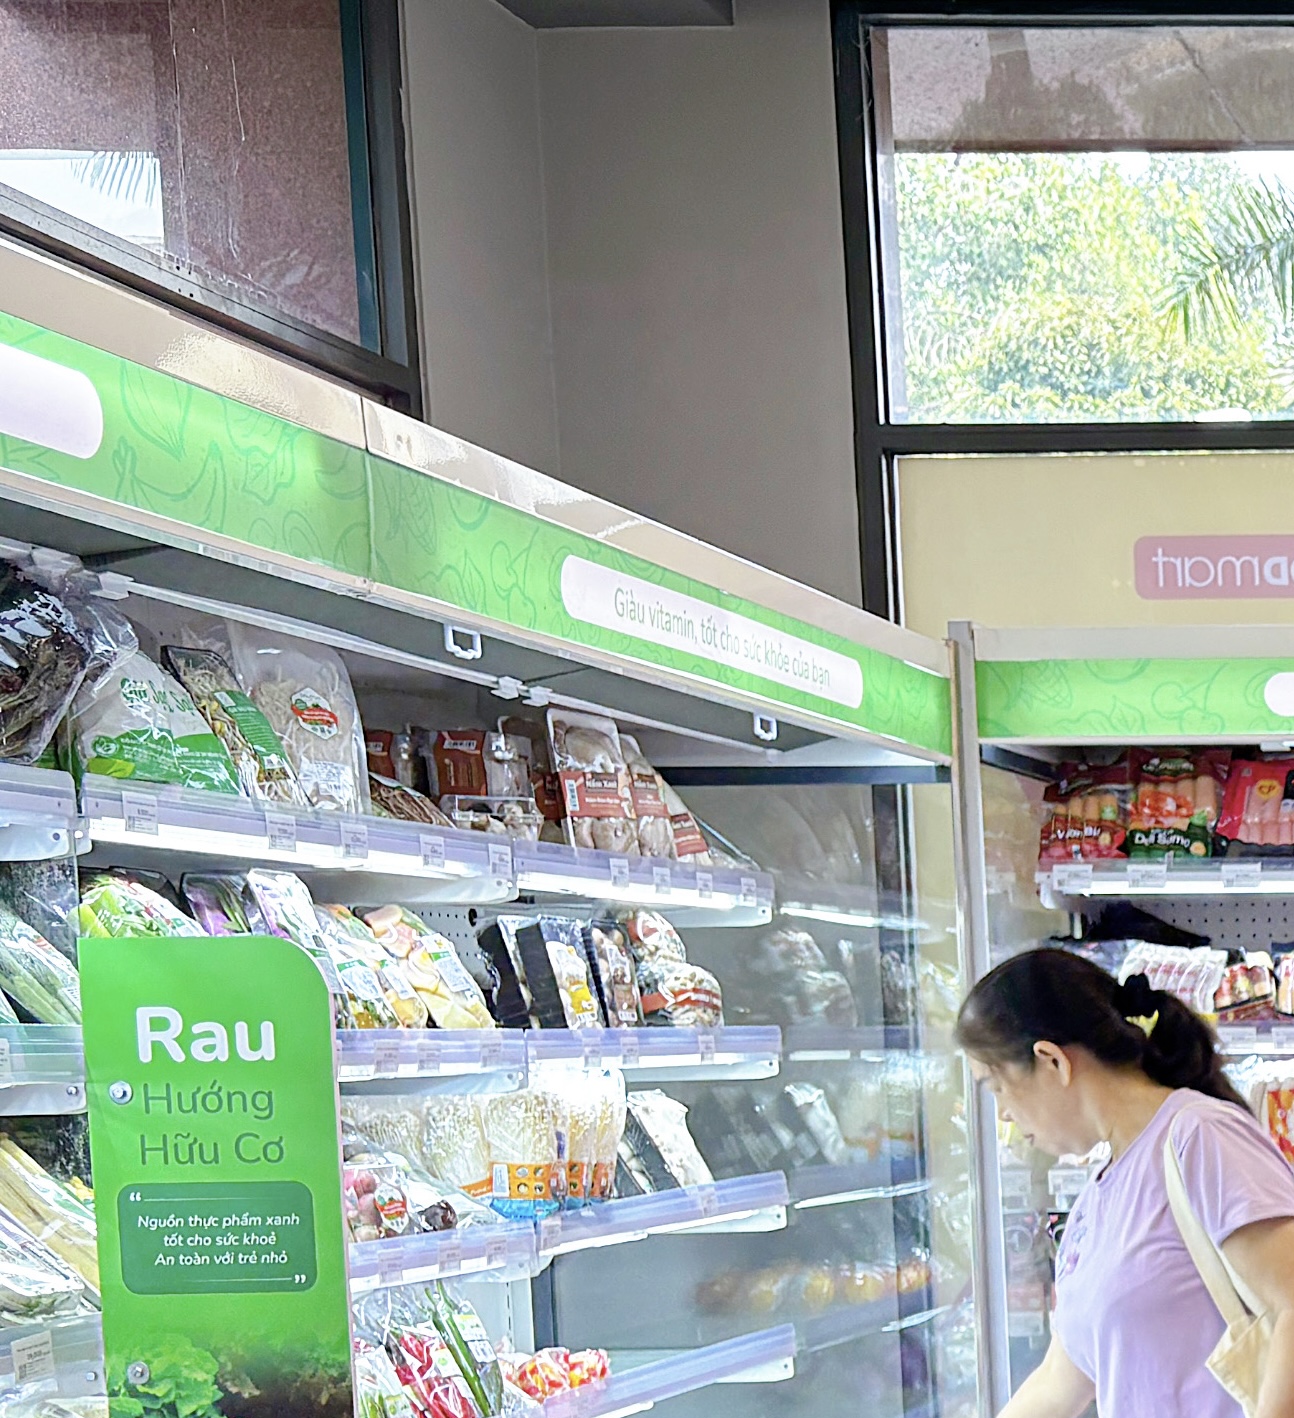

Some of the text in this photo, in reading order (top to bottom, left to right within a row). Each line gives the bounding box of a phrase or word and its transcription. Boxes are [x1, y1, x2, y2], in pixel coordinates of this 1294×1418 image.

[614, 586, 831, 692] Giàu vitamin, tốt cho sức khỏe của bạn
[136, 1006, 277, 1063] Rau
[142, 1079, 275, 1120] Hướng
[140, 1132, 285, 1166] Hữu Cơ
[138, 1211, 300, 1230] Nguồn thực phẩm xanh
[163, 1230, 184, 1247] tốt
[186, 1232, 212, 1246] cho
[215, 1231, 240, 1246] sức
[154, 1249, 288, 1266] An toàn với trẻ nhỏ
